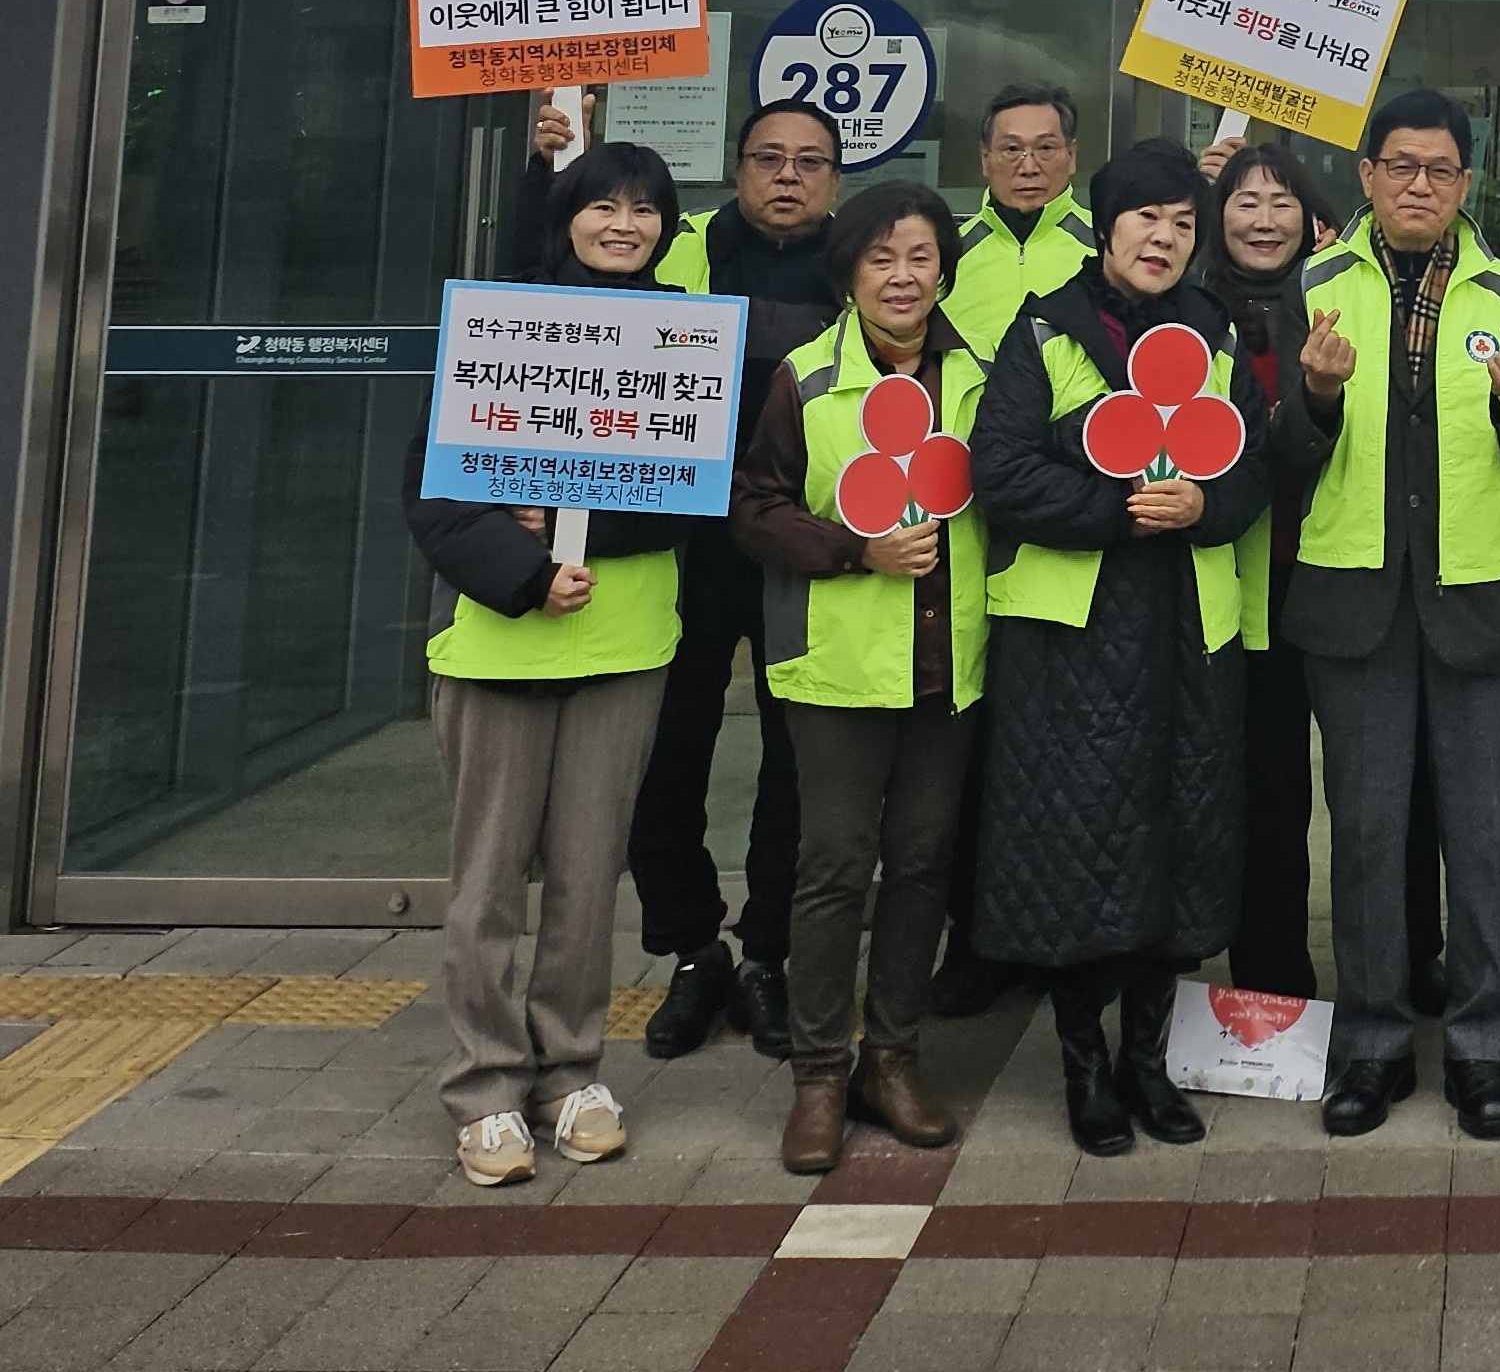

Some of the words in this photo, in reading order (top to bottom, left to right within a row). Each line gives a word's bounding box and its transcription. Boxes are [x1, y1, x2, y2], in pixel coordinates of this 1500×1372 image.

[449, 34, 676, 69] 청학동지역사회보장협의체
[1233, 6, 1302, 49] 희망을
[1305, 34, 1371, 72] 나눠요
[479, 56, 650, 86] 청학동행정복지센터
[781, 62, 908, 114] 287
[1179, 53, 1318, 114] 복지사각지대발굴단
[1173, 70, 1312, 129] 청학동행정복지센터
[837, 118, 884, 138] 대로
[264, 336, 306, 353] 청학동
[308, 336, 389, 353] 행정복지센터
[466, 317, 622, 346] 연수구맞춤형복지
[656, 327, 718, 347] Yeonsu
[453, 360, 610, 400] 복지사각지대,
[616, 369, 666, 401] 함께
[672, 373, 723, 402] 찾고
[470, 401, 522, 432] 나눔
[527, 405, 583, 439] 두배,
[589, 408, 640, 439] 행복
[646, 413, 697, 443] 두배
[460, 451, 697, 486] 청학동지역사회보장협의체
[487, 476, 664, 507] 청학동행정복지센터
